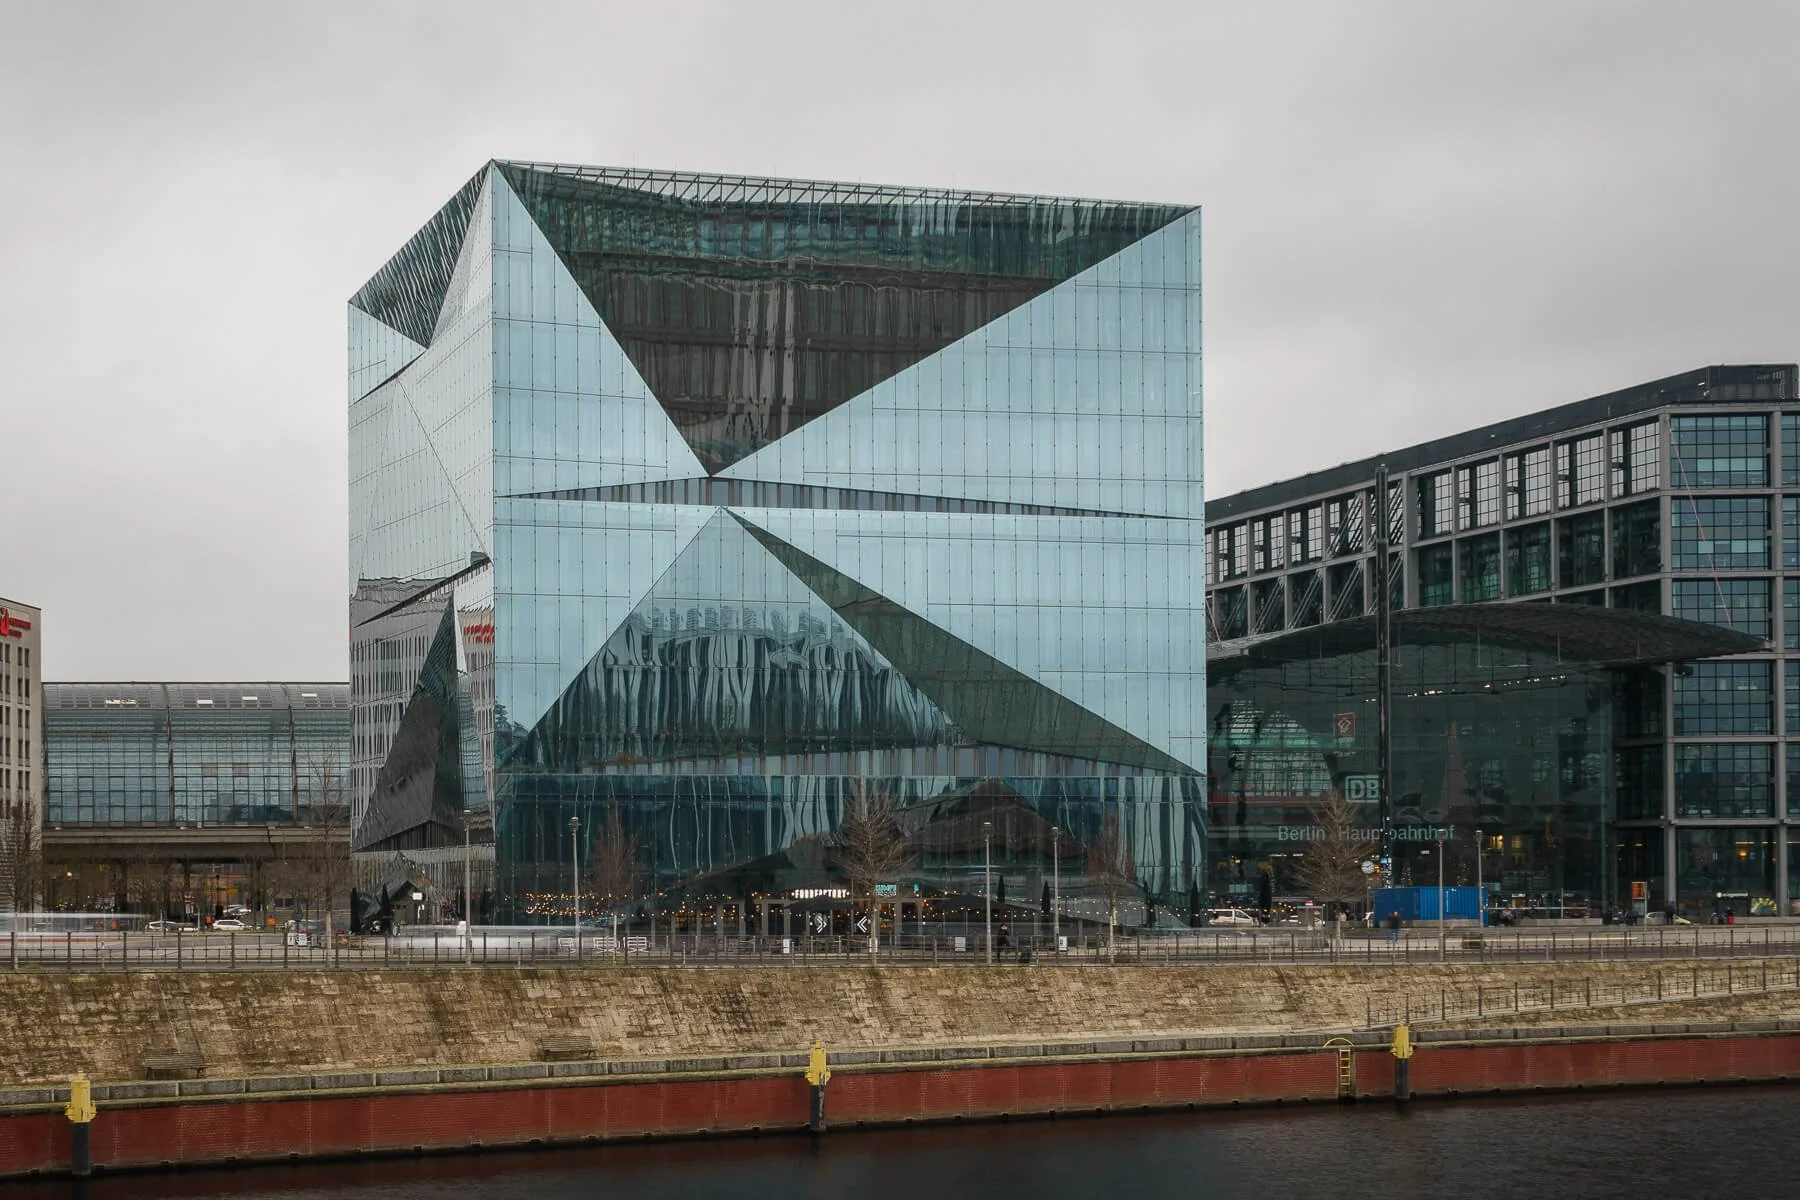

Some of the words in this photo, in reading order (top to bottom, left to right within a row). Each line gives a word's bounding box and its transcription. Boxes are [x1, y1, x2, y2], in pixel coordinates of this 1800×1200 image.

[1350, 780, 1379, 798] DB
[1278, 825, 1325, 841] Berlin
[1338, 824, 1456, 844] Haupbahnhof
